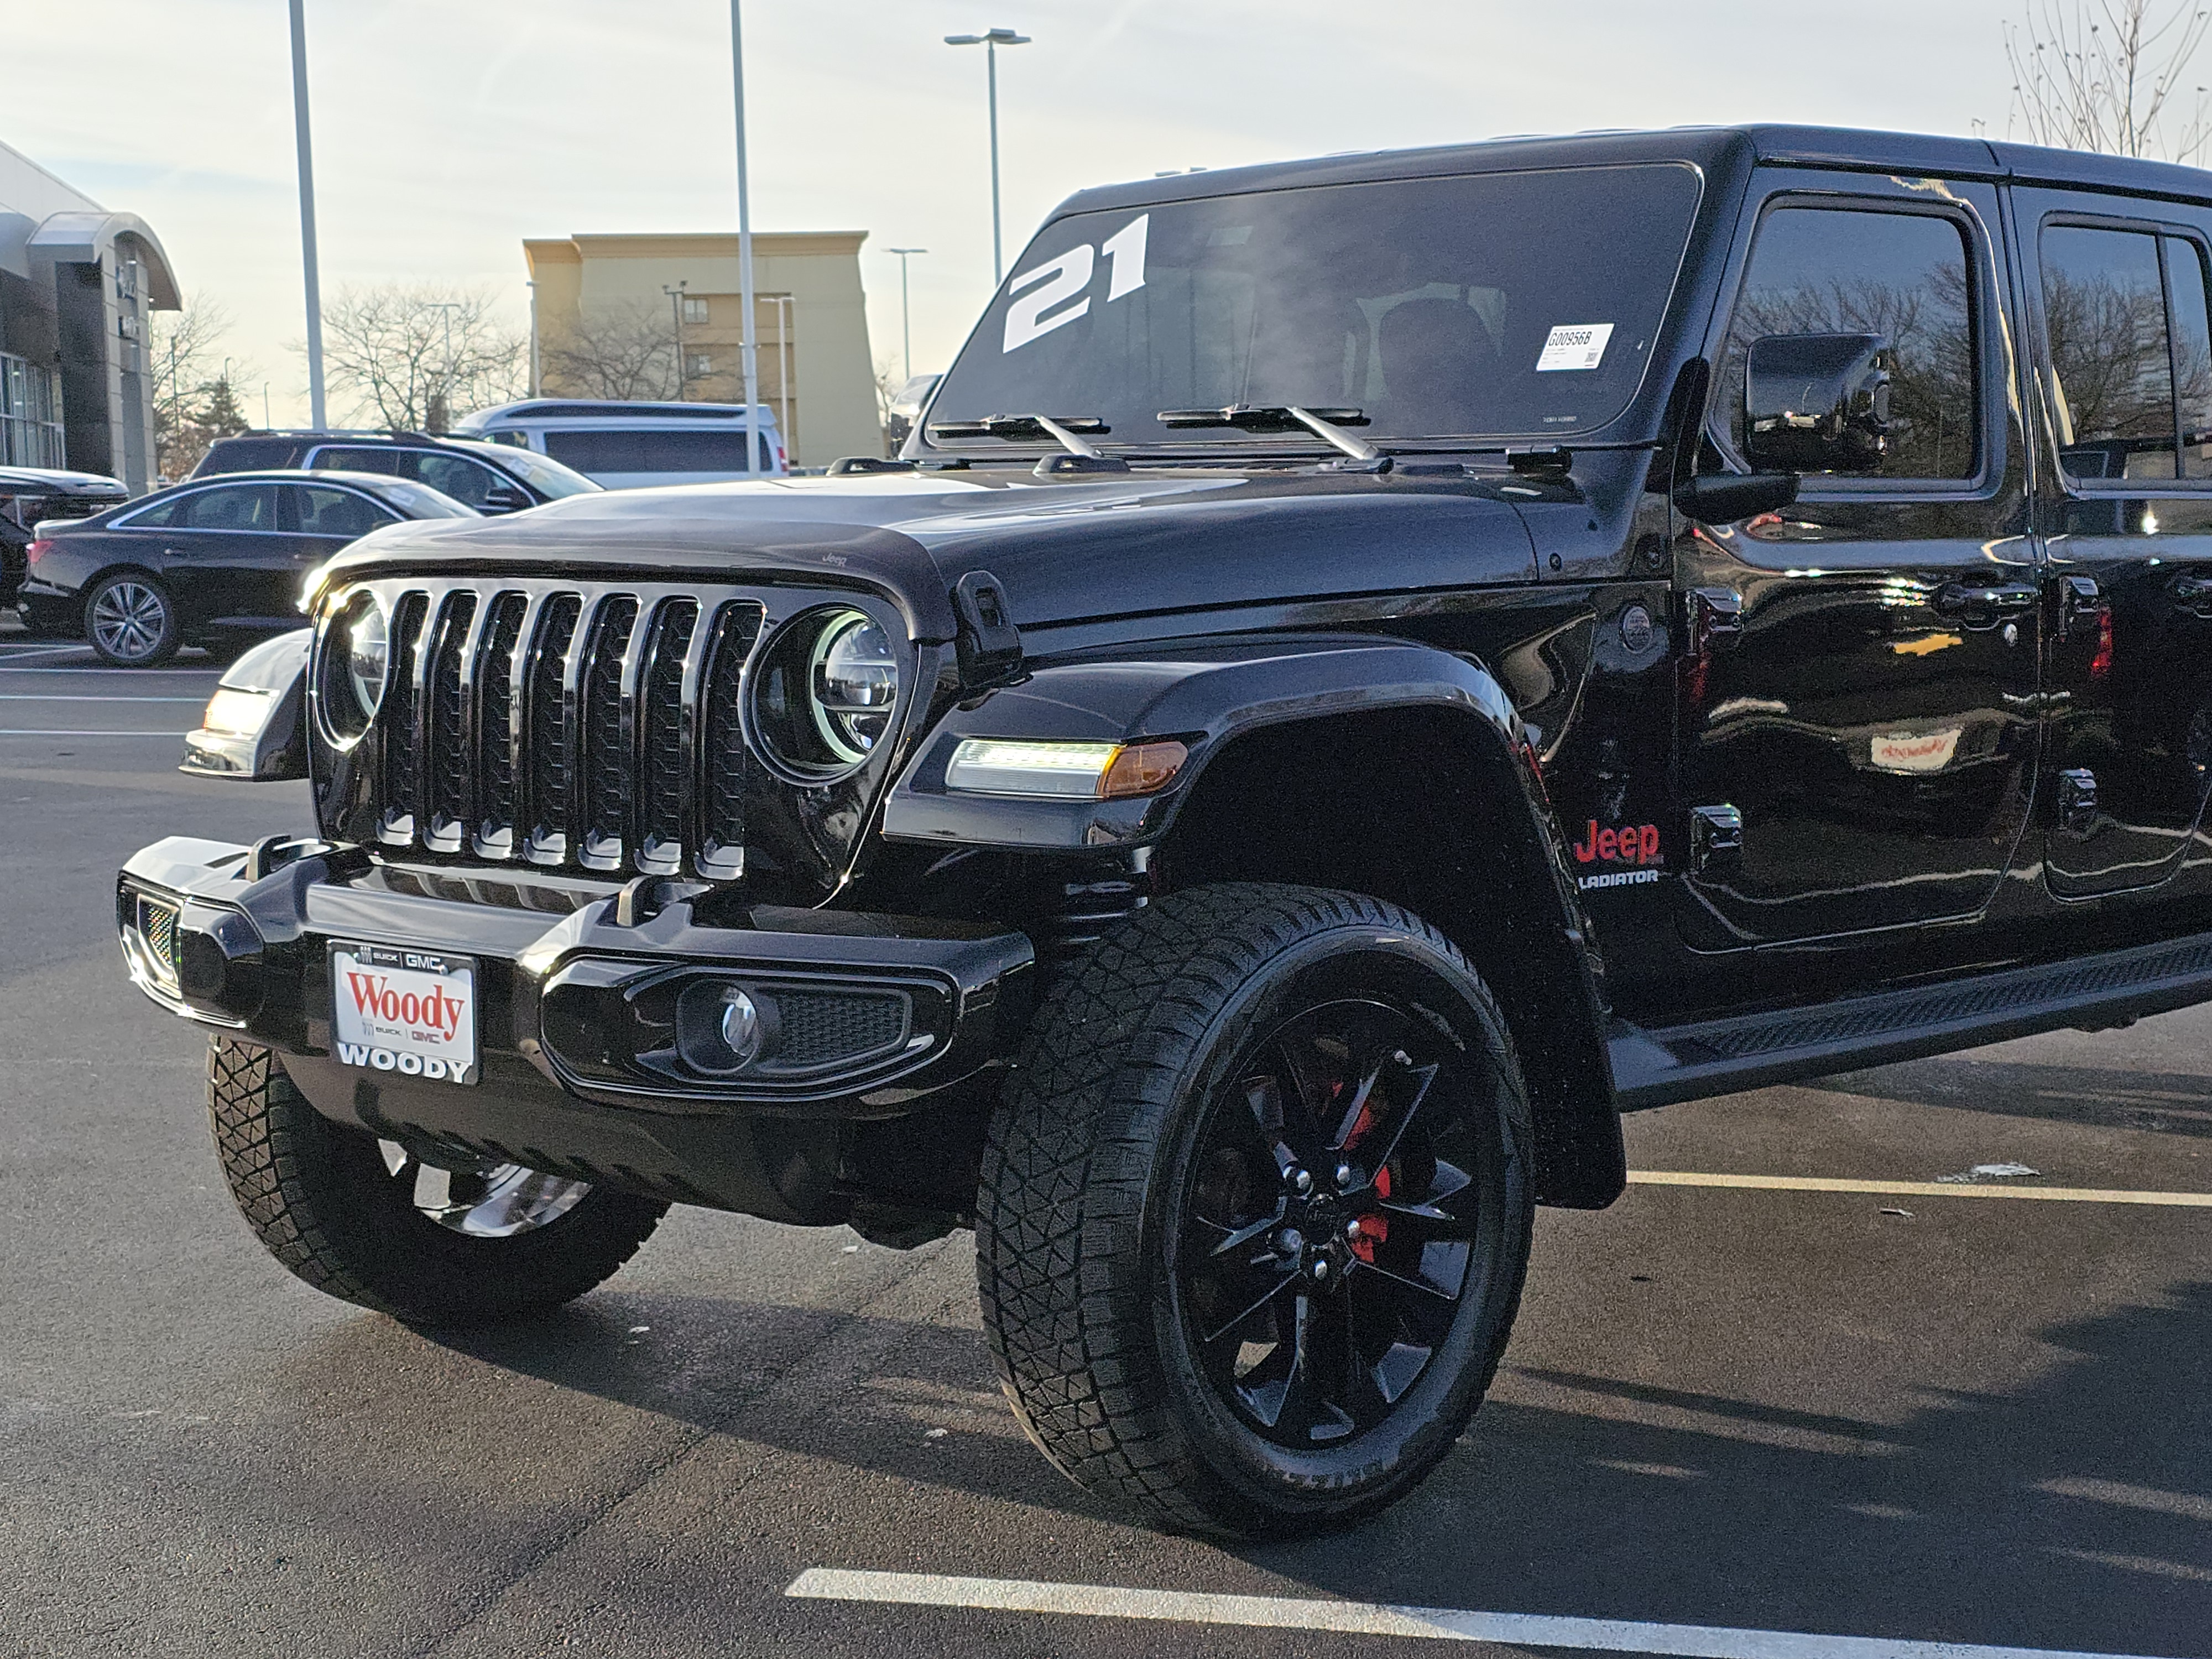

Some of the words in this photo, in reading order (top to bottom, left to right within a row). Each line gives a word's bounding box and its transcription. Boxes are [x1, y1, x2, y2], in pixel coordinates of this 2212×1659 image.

[1003, 213, 1149, 353] 21
[1574, 820, 1658, 864] Jeep
[1577, 869, 1658, 890] LADIATOR
[373, 952, 398, 962] BUICK
[406, 953, 441, 970] GMC
[347, 972, 465, 1041] Woody
[375, 1026, 402, 1036] BUICK
[411, 1031, 440, 1045] GMC
[337, 1043, 469, 1084] WOODY
